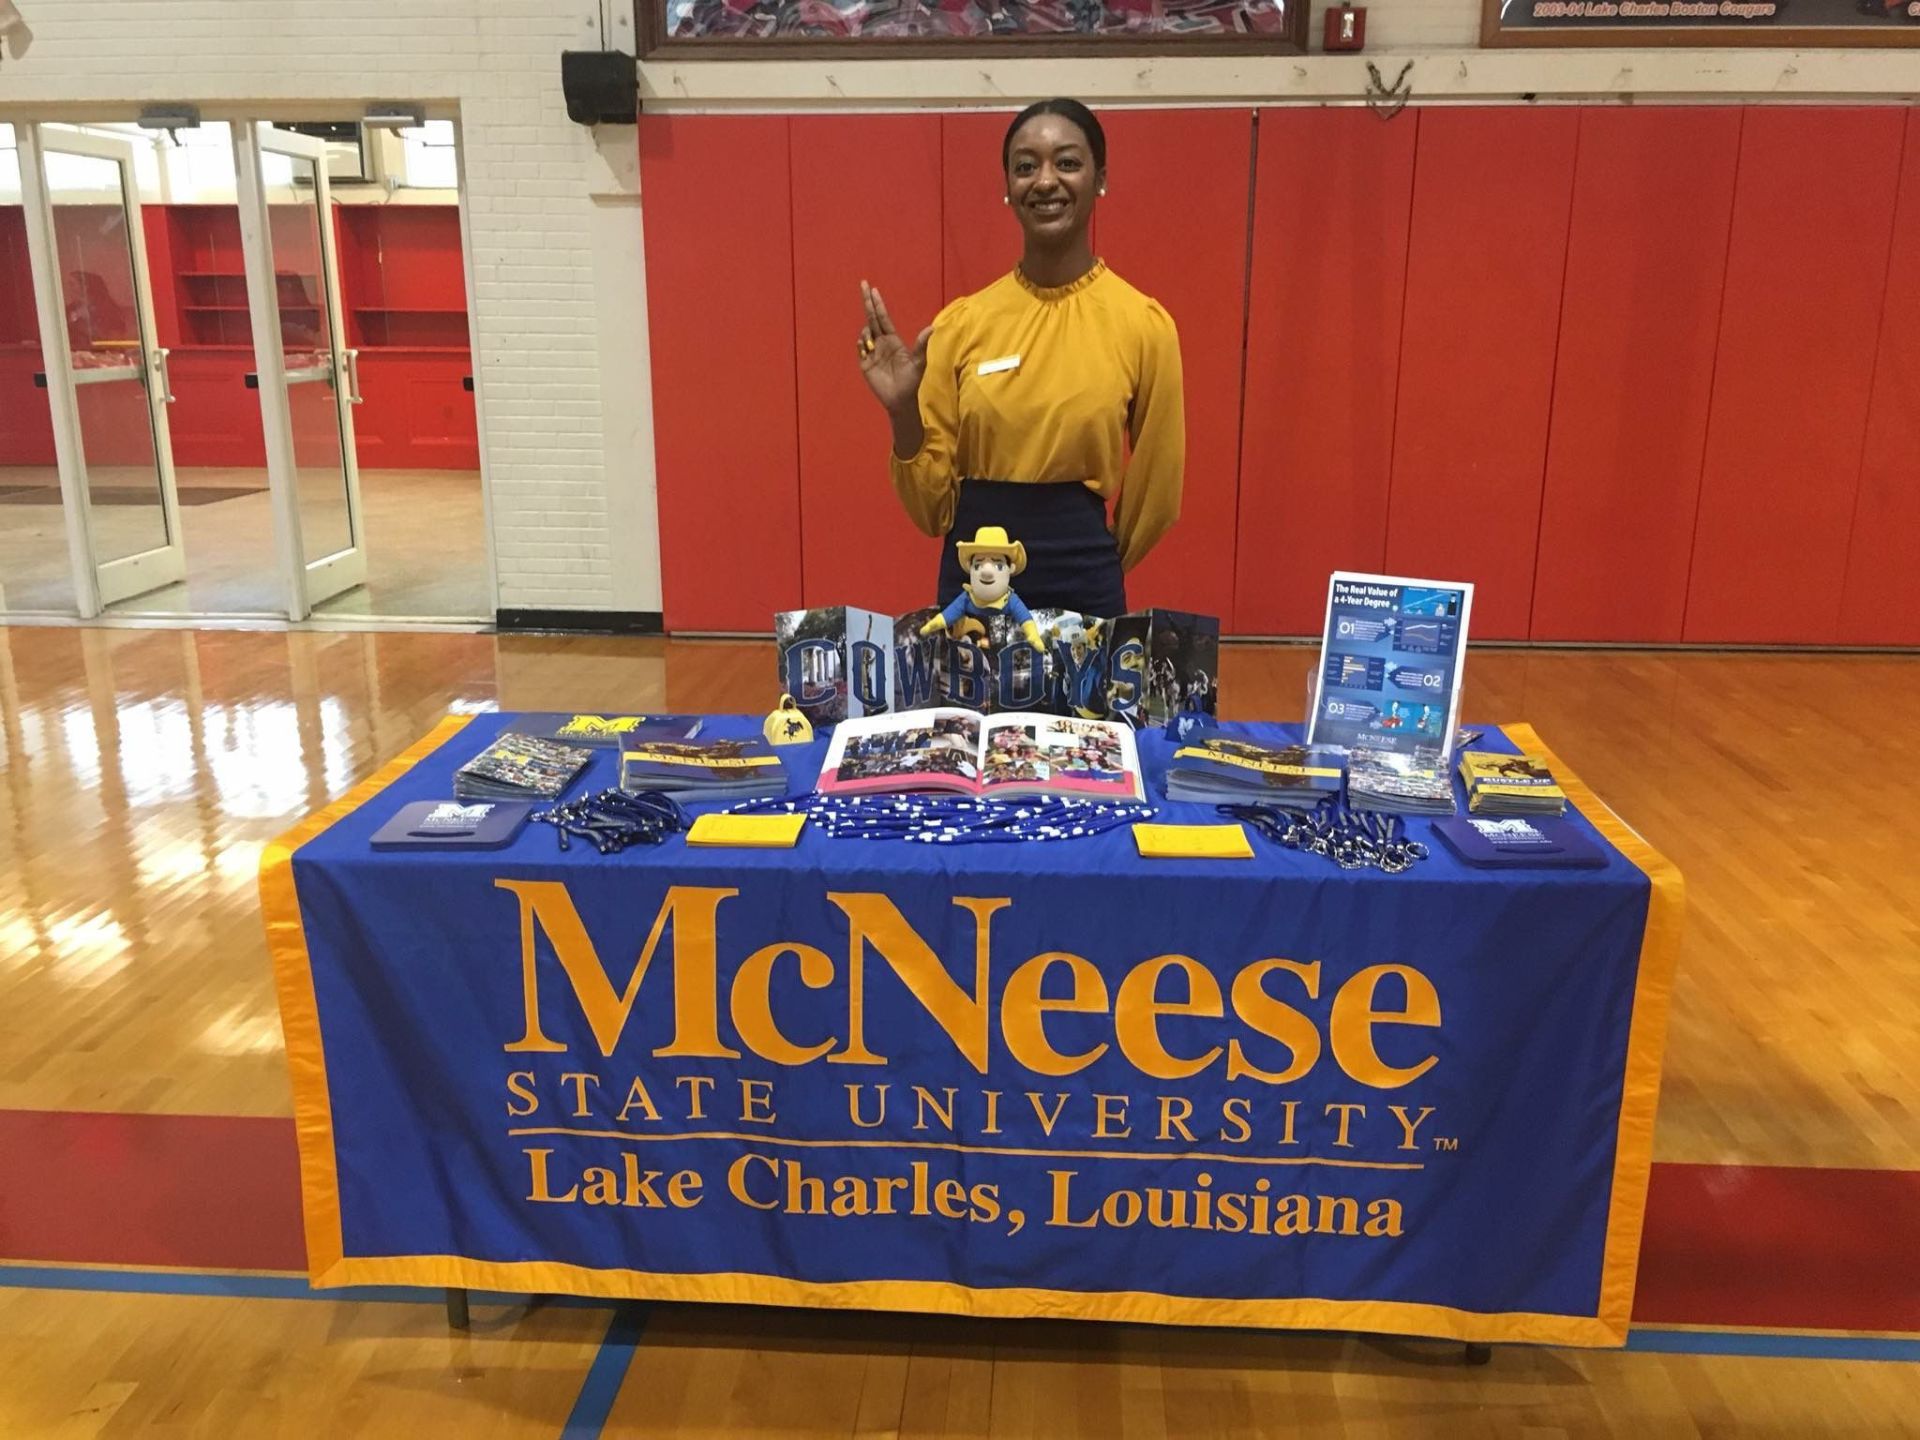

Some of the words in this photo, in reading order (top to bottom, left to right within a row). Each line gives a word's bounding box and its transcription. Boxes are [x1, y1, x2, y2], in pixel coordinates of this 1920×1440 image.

[1533, 2, 1583, 17] 2003-04
[1584, 2, 1618, 16] Lake
[1618, 1, 1668, 16] Charles
[1670, 1, 1718, 16] Boston
[1719, 1, 1776, 18] Cougars
[1335, 583, 1349, 593] The
[1350, 585, 1367, 595] Real
[1368, 586, 1388, 597] Value
[1389, 588, 1399, 597] of
[1339, 596, 1364, 606] 4-Year
[1364, 598, 1391, 609] Degree
[1339, 621, 1355, 634] 01
[784, 637, 1145, 712] COWBOYS
[1423, 674, 1441, 687] 02
[1328, 702, 1345, 715] 03
[494, 877, 1442, 1090] McNeese
[505, 1070, 778, 1125] STATE
[843, 1083, 1437, 1152] UNIVERSITY
[522, 1148, 704, 1209] Lake
[727, 1153, 1026, 1236] Charles,
[1045, 1169, 1405, 1238] Louisiana
